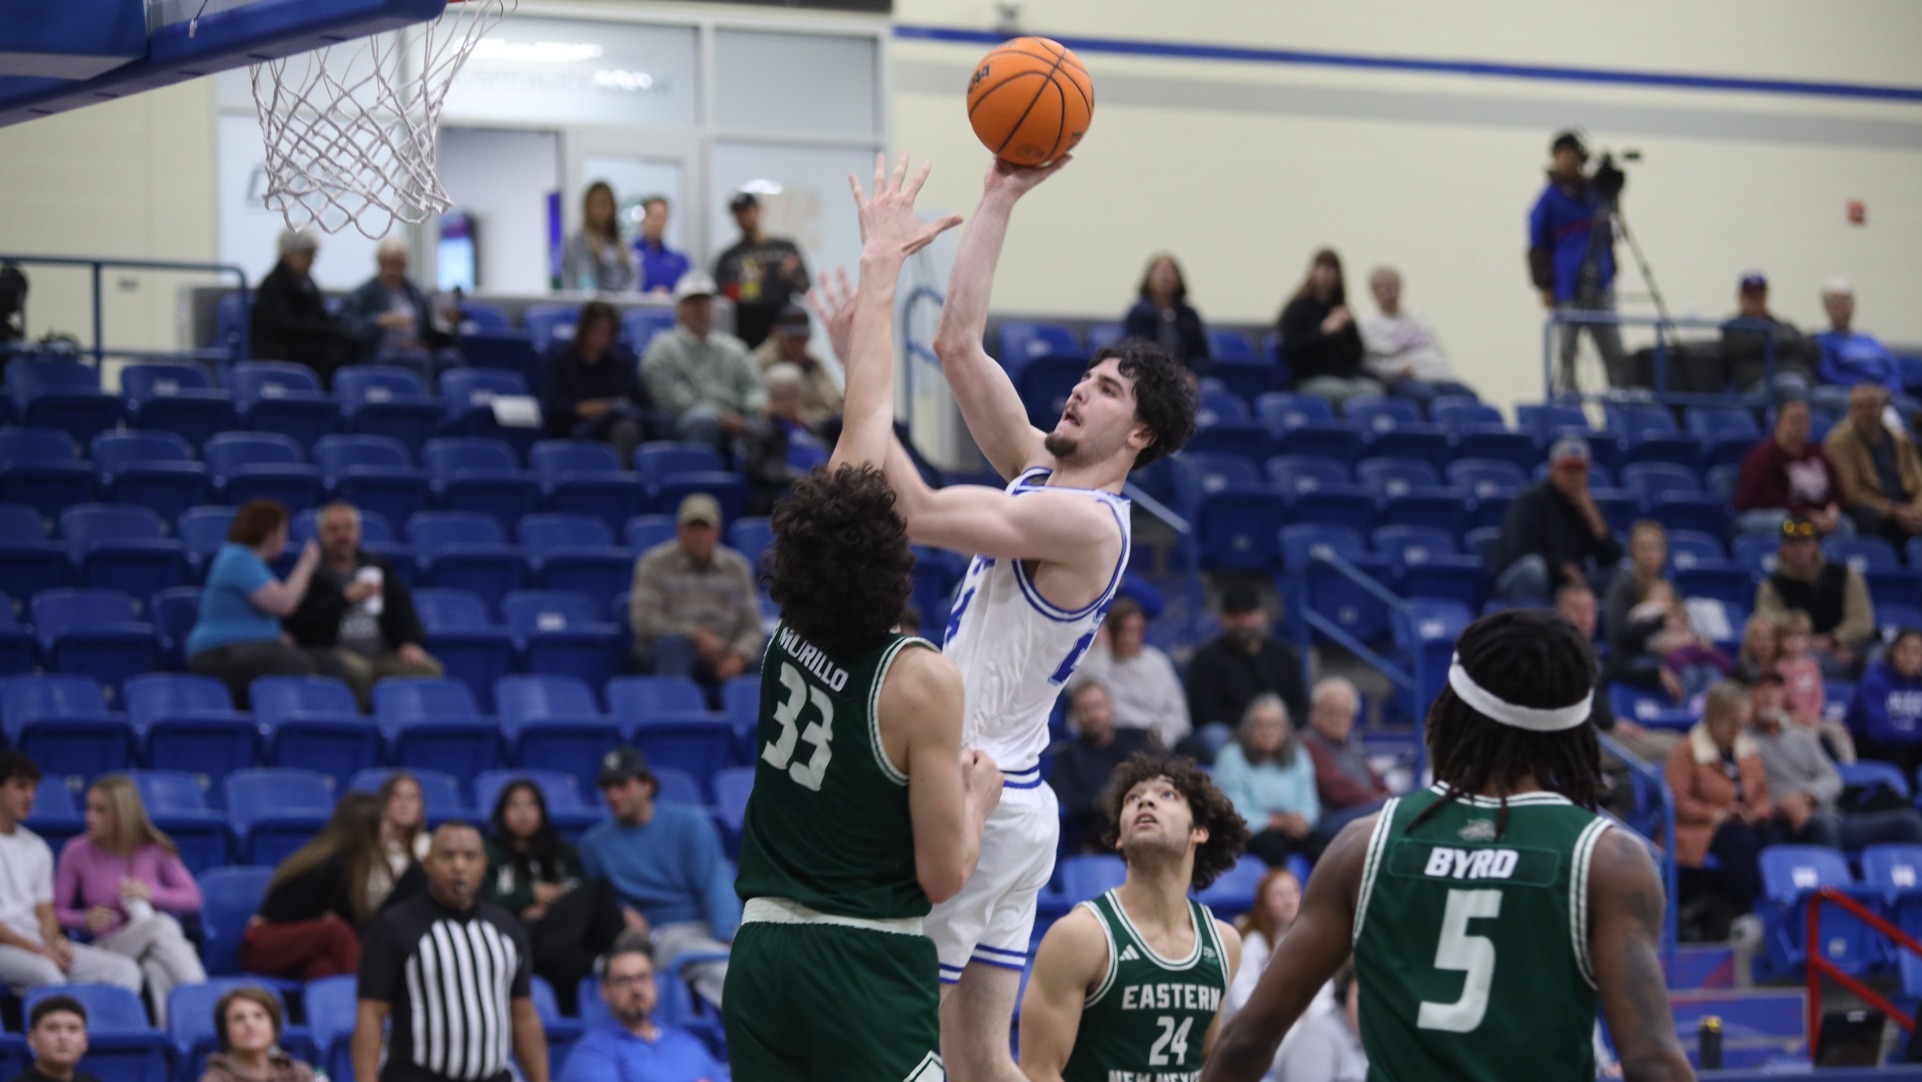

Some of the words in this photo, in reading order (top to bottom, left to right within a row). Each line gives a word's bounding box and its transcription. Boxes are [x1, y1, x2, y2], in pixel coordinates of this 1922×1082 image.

[777, 626, 850, 692] MURILLO
[760, 661, 835, 792] 33
[1424, 846, 1520, 879] BYRD
[1416, 888, 1504, 1033] 5
[1121, 982, 1221, 1011] EASTERN
[1148, 1015, 1194, 1066] 24
